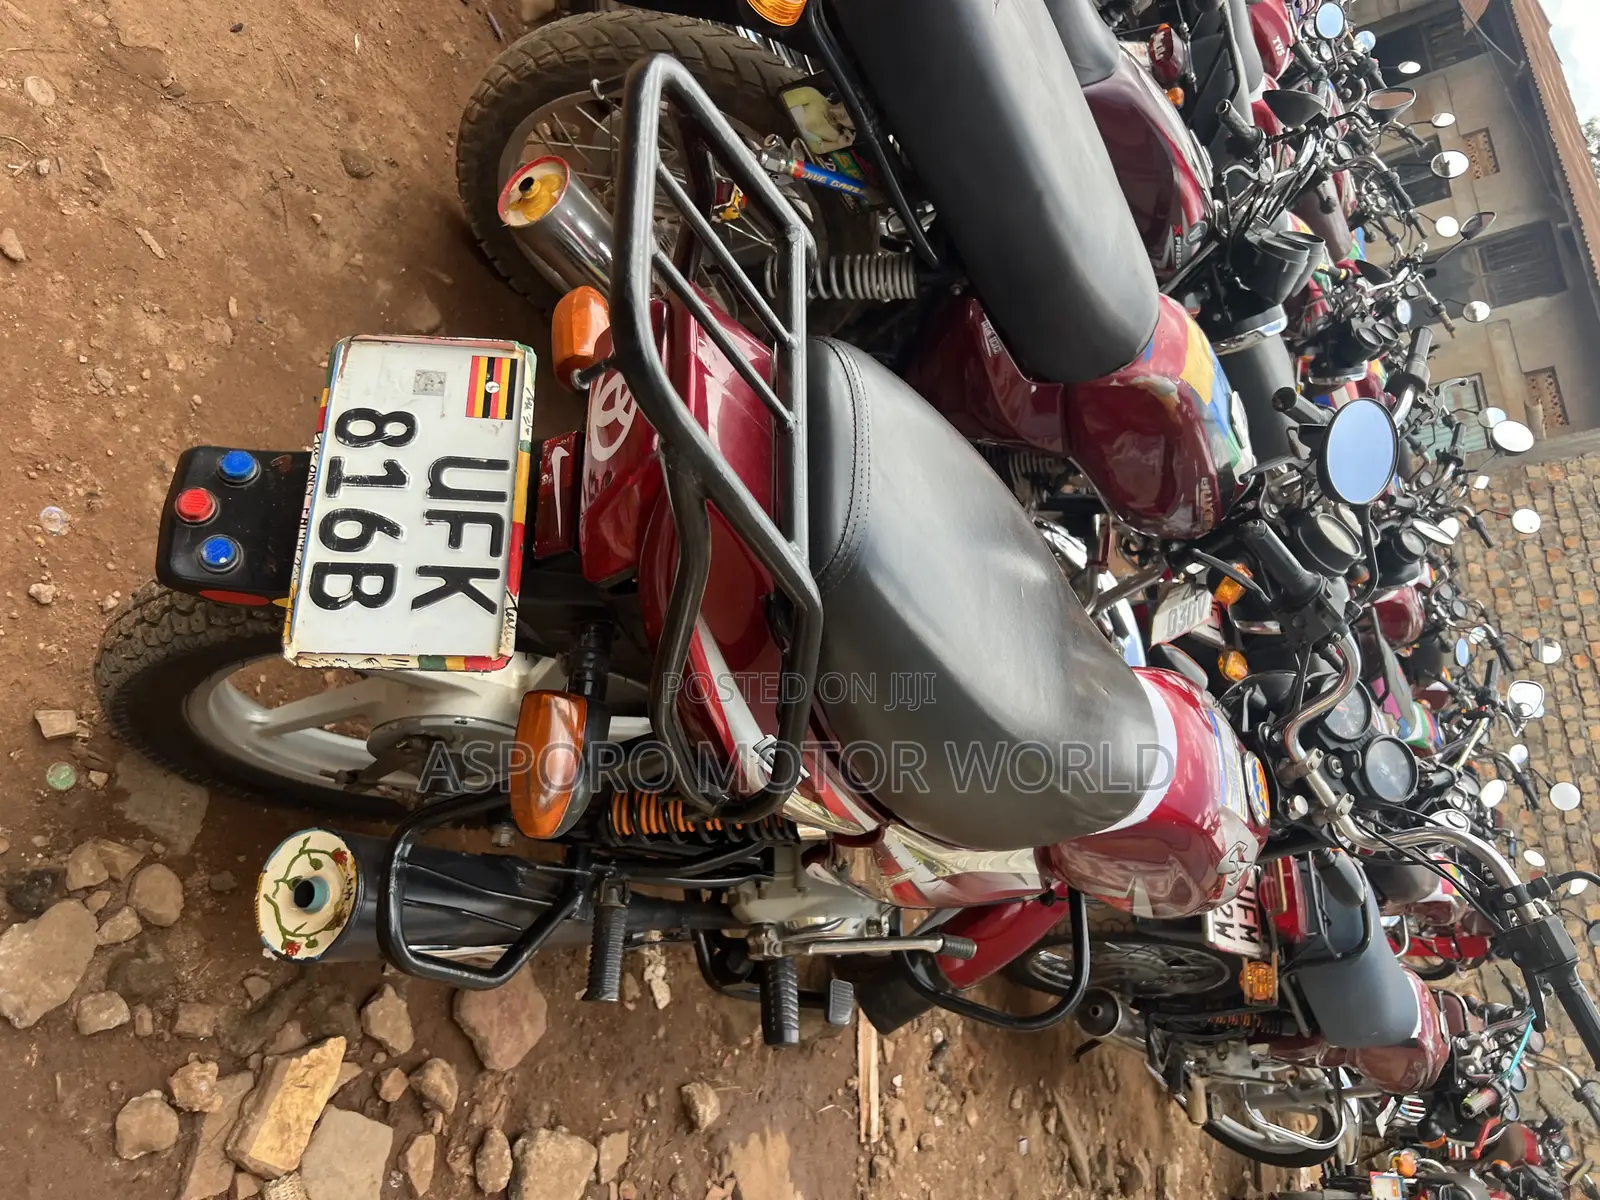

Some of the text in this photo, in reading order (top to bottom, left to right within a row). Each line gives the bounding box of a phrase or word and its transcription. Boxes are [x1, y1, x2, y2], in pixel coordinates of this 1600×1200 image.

[1272, 35, 1286, 57] TVS
[1172, 223, 1184, 270] XPRESS
[305, 464, 317, 497] ONLY
[308, 407, 418, 611] 816B
[410, 455, 511, 616] UFK
[1214, 903, 1235, 941] 2W
